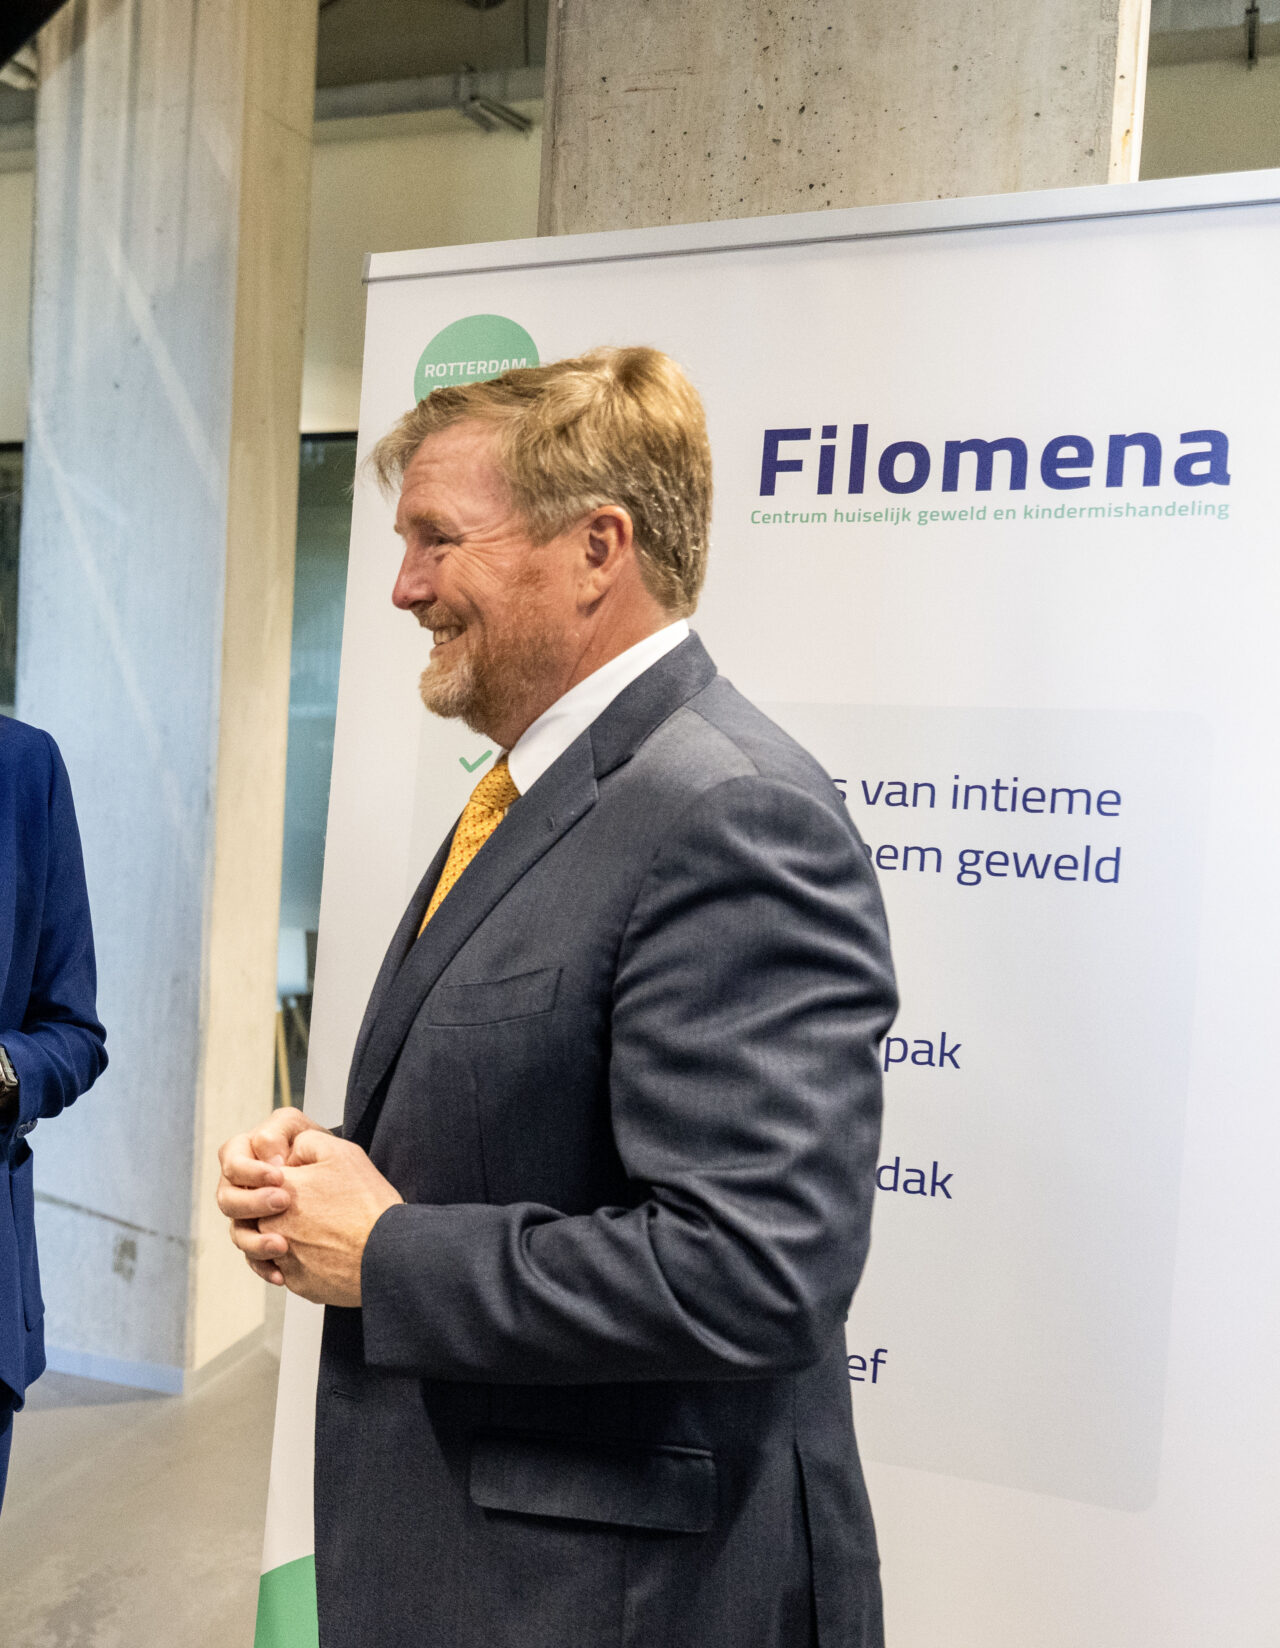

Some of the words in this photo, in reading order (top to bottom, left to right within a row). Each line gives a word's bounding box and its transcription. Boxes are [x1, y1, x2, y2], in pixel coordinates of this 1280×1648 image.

[759, 423, 1231, 496] Filomena
[750, 510, 828, 525] Centrum
[833, 508, 911, 526] huiselijk
[917, 505, 987, 526] geweld
[993, 509, 1017, 521] en
[1023, 500, 1230, 521] kindermishandeling
[861, 780, 936, 809] van
[951, 774, 1122, 817] intieme
[956, 844, 1122, 886] geweld
[883, 1031, 962, 1072] pak
[875, 1156, 954, 1200] dak
